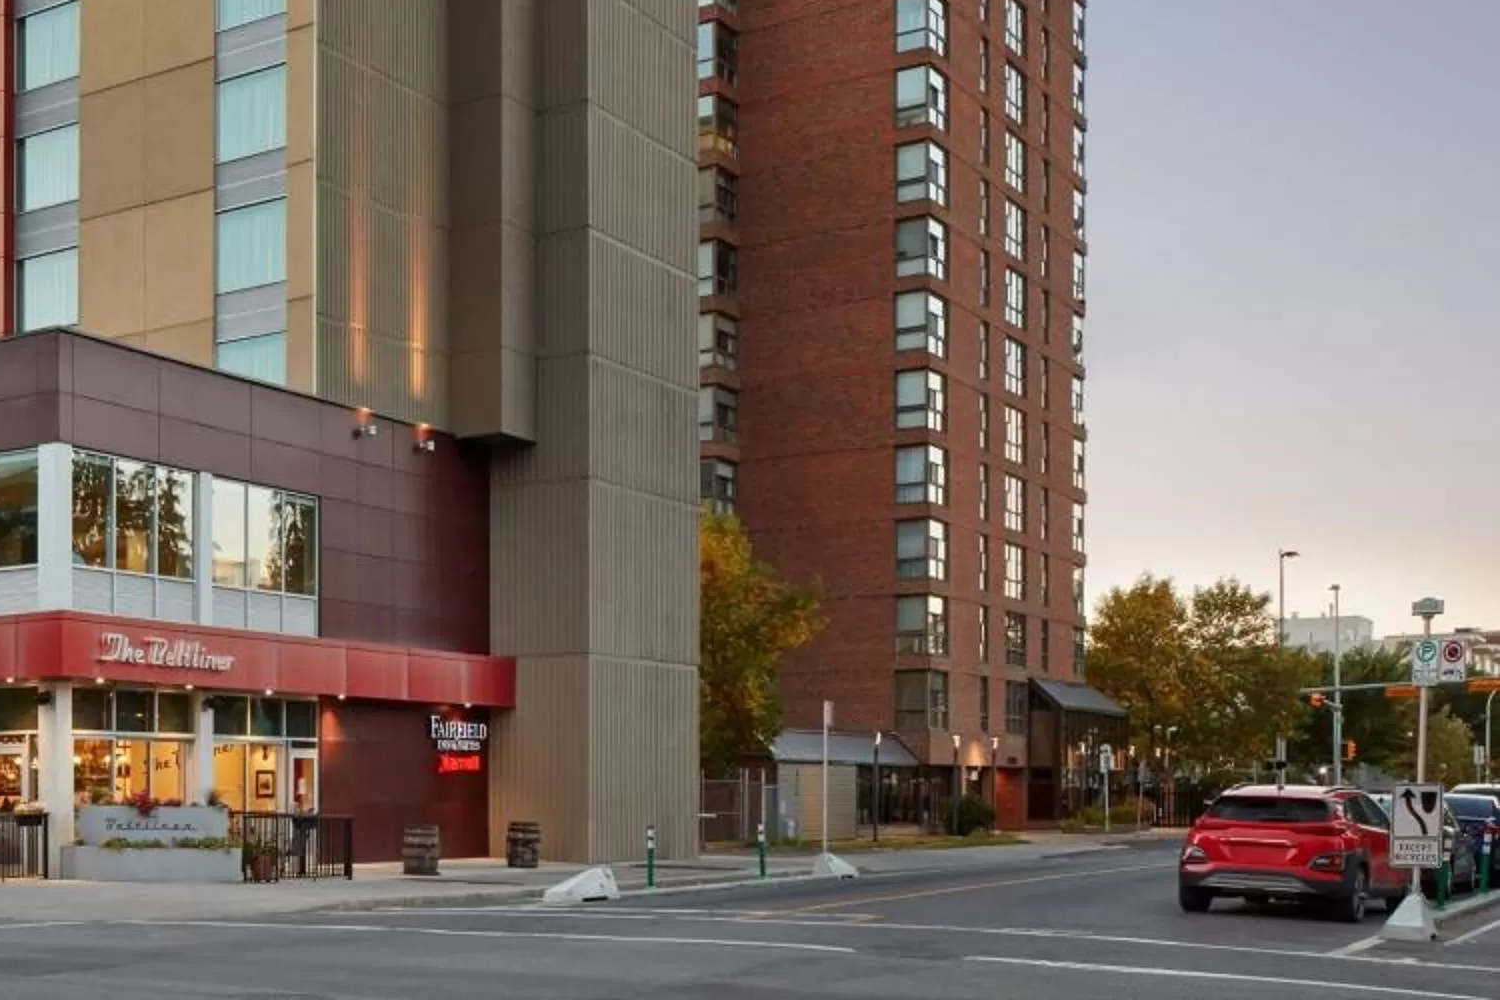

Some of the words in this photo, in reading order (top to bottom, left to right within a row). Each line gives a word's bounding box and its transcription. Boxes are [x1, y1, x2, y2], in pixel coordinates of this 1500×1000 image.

[100, 632, 145, 663] The
[145, 636, 236, 671] Beltliner
[431, 715, 487, 739] FAIRFIELD
